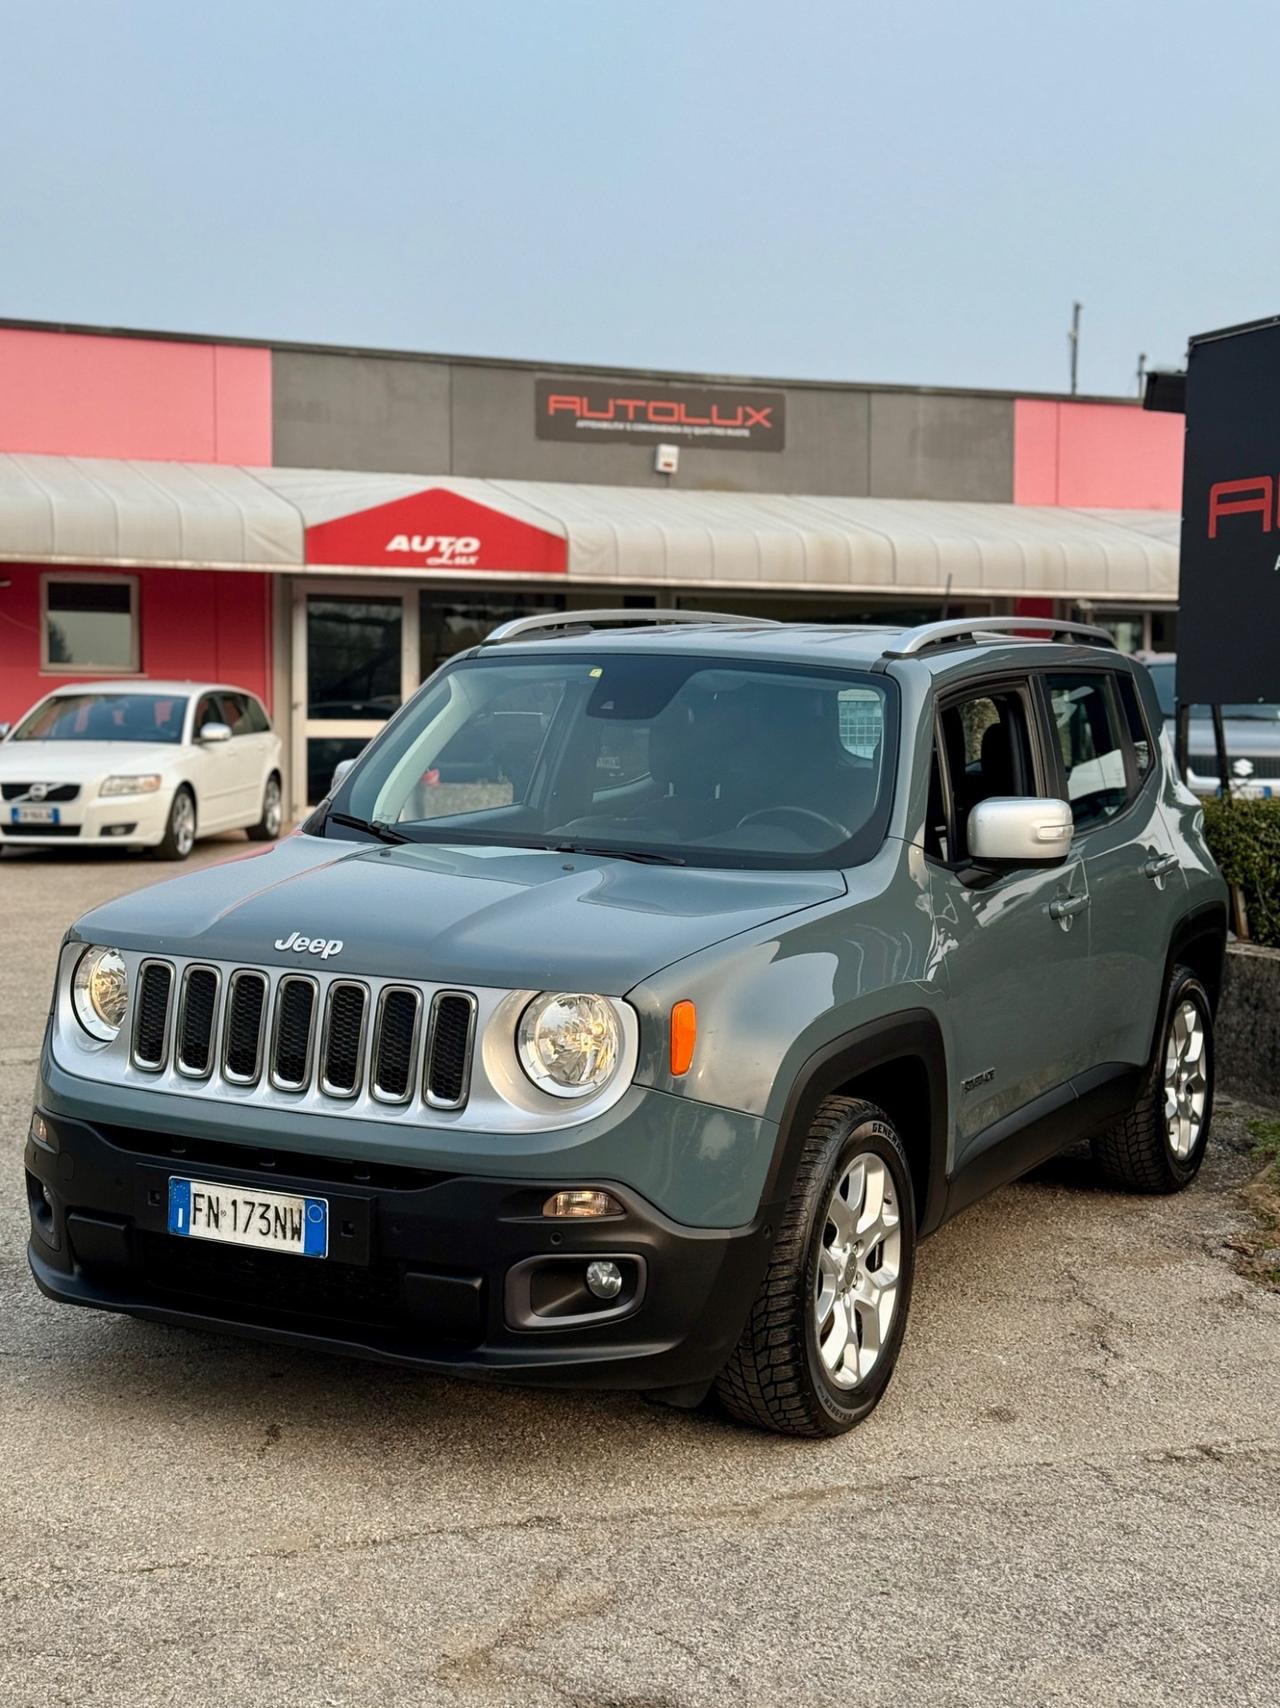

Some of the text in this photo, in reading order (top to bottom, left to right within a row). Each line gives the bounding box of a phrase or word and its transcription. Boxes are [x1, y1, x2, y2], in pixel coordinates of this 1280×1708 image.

[547, 394, 773, 428] AUTOLUX
[1208, 473, 1280, 539] A
[384, 533, 481, 554] AUTO
[274, 931, 344, 960] Jeep
[192, 1192, 302, 1243] FN 173NW
